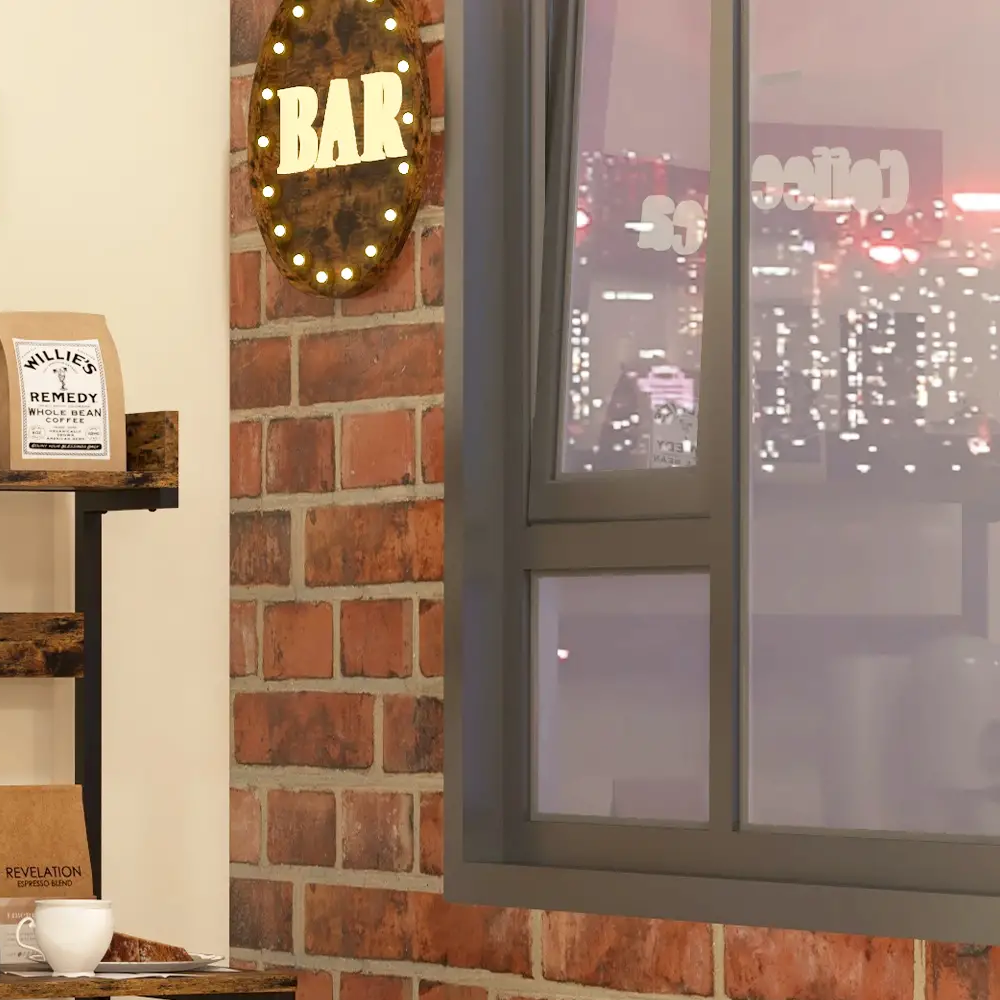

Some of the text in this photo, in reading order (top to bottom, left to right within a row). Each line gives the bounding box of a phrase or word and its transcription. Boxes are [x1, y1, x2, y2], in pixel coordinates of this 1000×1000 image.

[276, 71, 408, 175] BAR
[24, 349, 97, 374] WILLIE'S
[30, 392, 98, 403] REMEDY
[28, 407, 102, 417] WHOLE BEAN
[5, 866, 82, 878] REVELATION
[51, 879, 73, 887] BLEND
